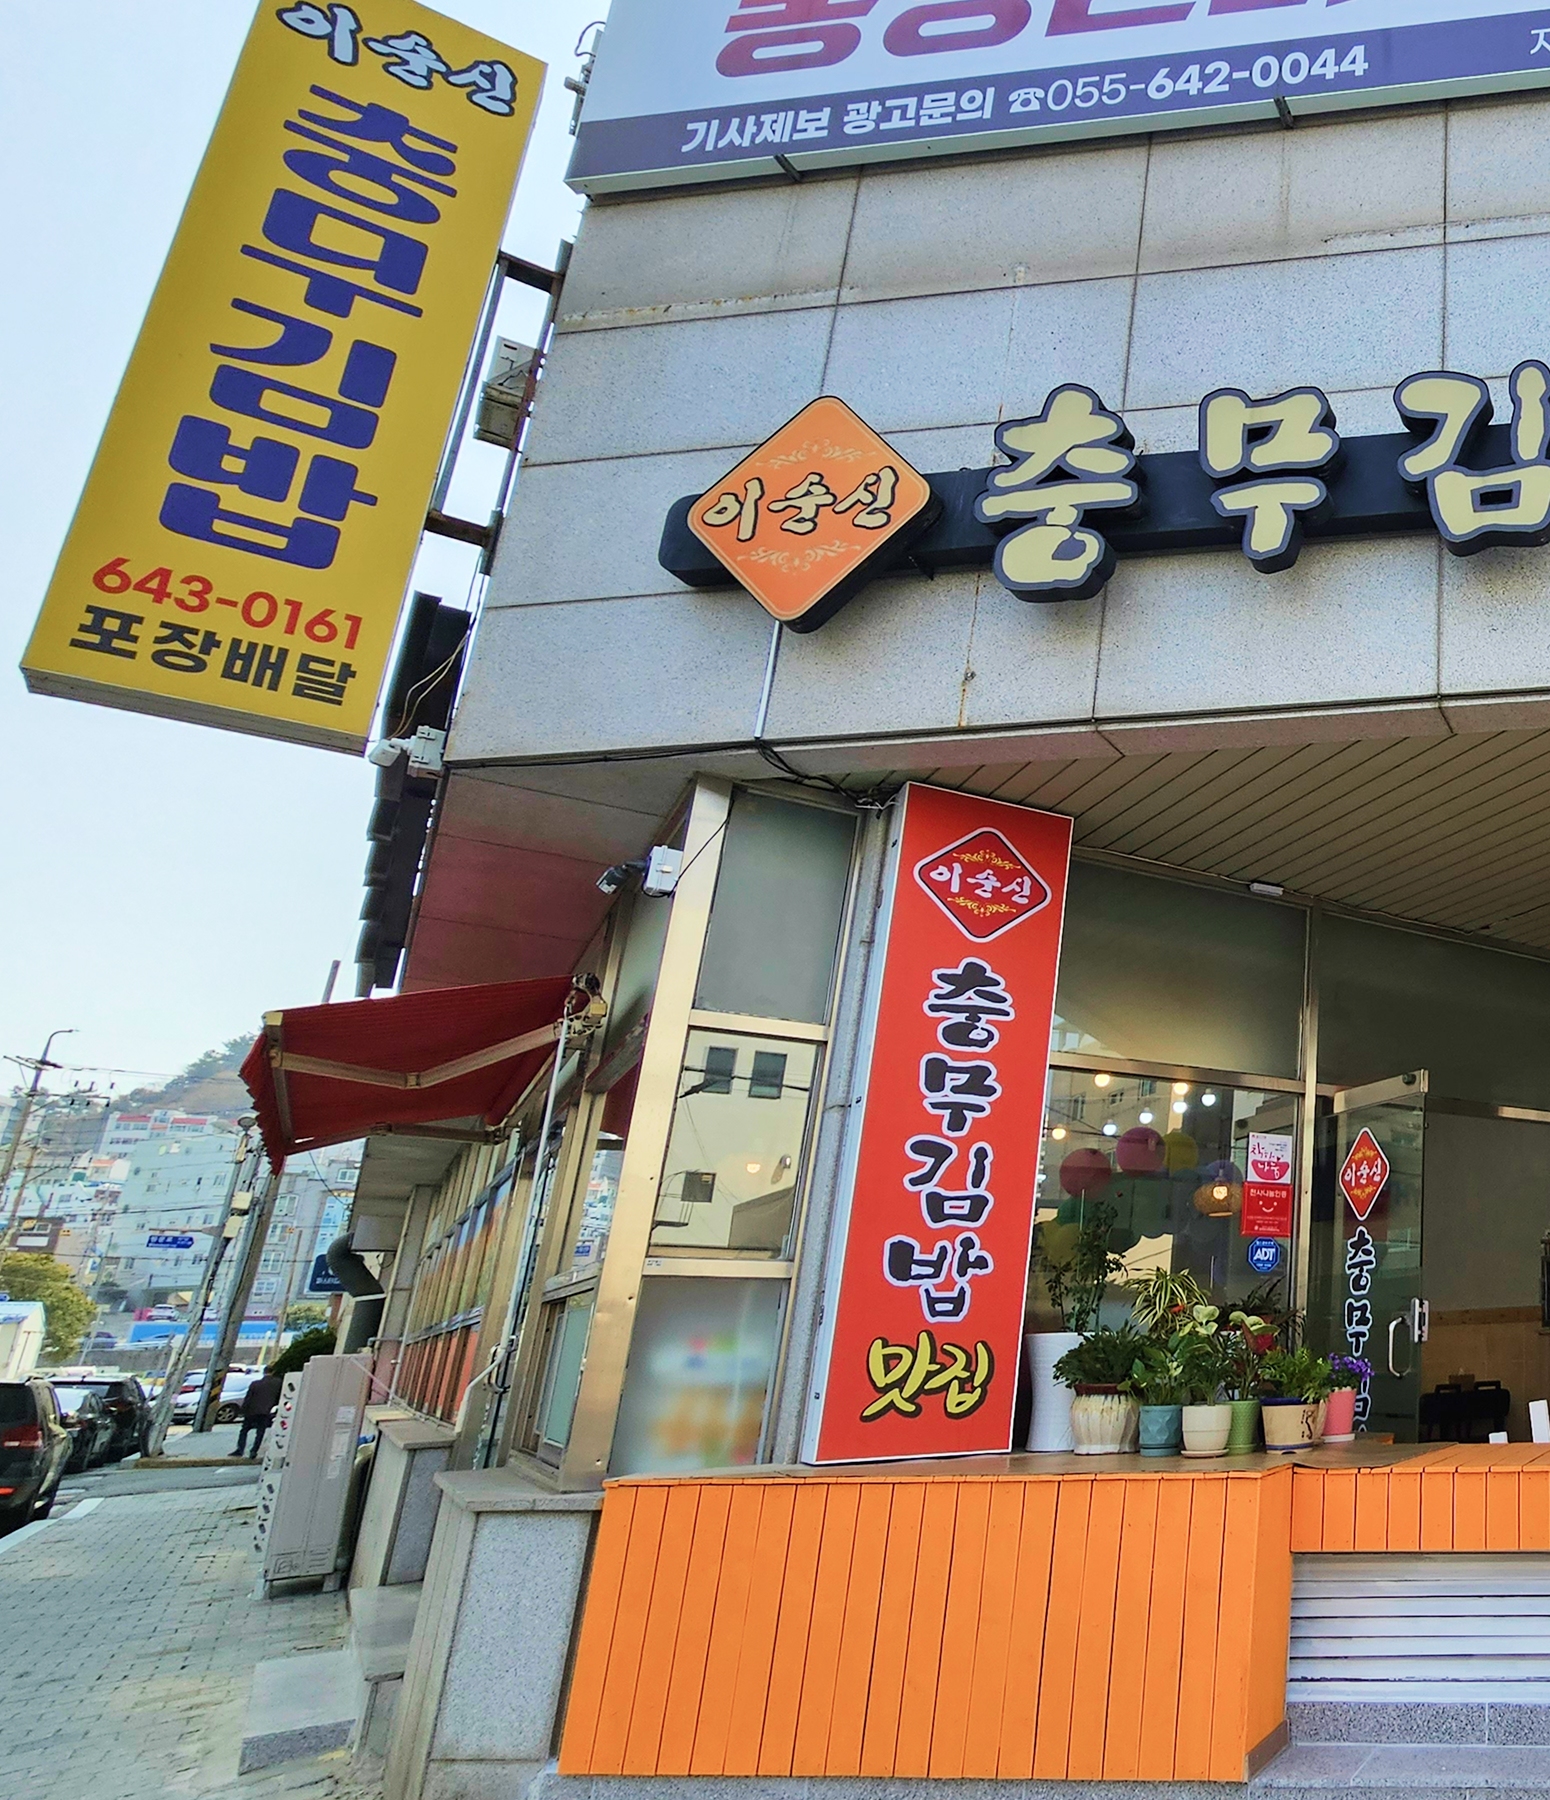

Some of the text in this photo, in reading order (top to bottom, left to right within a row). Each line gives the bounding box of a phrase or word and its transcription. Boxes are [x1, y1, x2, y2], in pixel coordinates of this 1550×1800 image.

[276, 2, 518, 117] 이순신
[681, 45, 1369, 152] 기사제보 광고문의 055-642-0044
[158, 84, 458, 571] 충무김밥
[702, 465, 900, 543] 이순신
[91, 556, 363, 651] 643-0161
[68, 604, 358, 706] 포장배달
[929, 862, 1032, 905] 이순신
[883, 957, 1015, 1323] 충무김밥
[1253, 1247, 1275, 1261] ADT
[860, 1329, 994, 1422] 맛집
